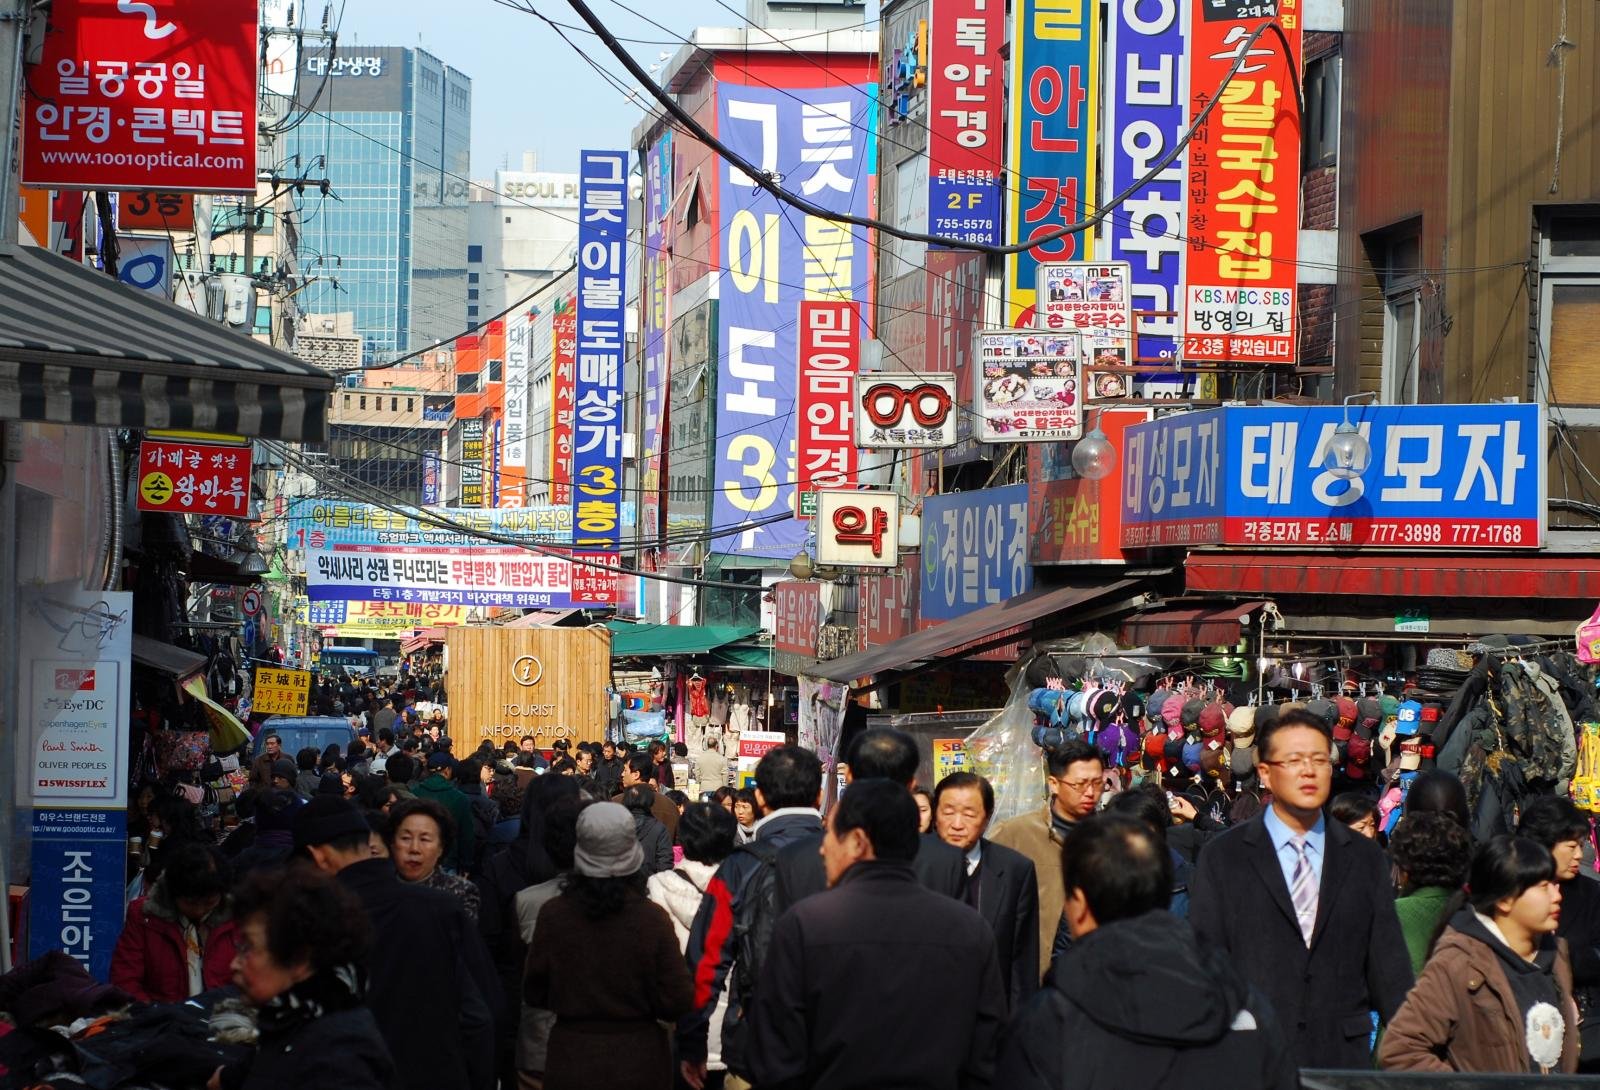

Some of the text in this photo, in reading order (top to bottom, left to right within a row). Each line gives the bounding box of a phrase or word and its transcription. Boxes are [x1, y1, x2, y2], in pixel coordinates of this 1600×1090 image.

[307, 56, 384, 77] 대한생명
[57, 58, 205, 99] 일공공일
[36, 105, 245, 145] 안경·콘텍트
[727, 98, 857, 197] 그릇
[42, 150, 244, 171] www.1001optical.com
[504, 182, 559, 199] SEOUL
[1216, 80, 1282, 280] 칼국수집
[936, 218, 993, 237] 755-5578
[1048, 268, 1072, 279] KBS
[1087, 267, 1121, 278] MBC
[1194, 289, 1290, 306] KBS.MBC.SBS
[1047, 313, 1126, 329] 손 칼국수
[1194, 310, 1284, 333] 방영의 집
[983, 336, 1005, 348] KBS
[1187, 338, 1296, 358] 2.3층 방있습니다
[804, 307, 855, 489] 믿음안경
[1012, 417, 1077, 430] 손 칼국수
[1126, 417, 1220, 514] 태성모자
[1239, 420, 1526, 507] 태성모자
[143, 473, 246, 510] 손 왕만두
[577, 466, 619, 532] 3층
[313, 504, 408, 531] 아름다움을
[297, 527, 326, 549] 1층
[833, 506, 888, 558] 약
[1252, 520, 1301, 543] 각종모자
[1369, 523, 1442, 544] 777-3898
[1451, 524, 1523, 544] 777-1768
[942, 502, 1028, 608] 경일안경
[318, 555, 363, 580] 악세사리
[367, 558, 390, 582] 상권
[393, 558, 448, 584] 무너뜨리는
[452, 559, 496, 586] 무분별한
[499, 561, 545, 588] 개발업자
[373, 588, 392, 600] E동
[417, 590, 463, 603] 개발저지
[467, 592, 514, 605] 비상대책
[517, 593, 551, 606] 위원회
[777, 587, 818, 648] 믿음안경
[260, 672, 306, 687] 京城社
[503, 704, 556, 717] TOURIST
[481, 725, 578, 739] INFORMATION
[42, 739, 104, 753] Paul Smith
[38, 761, 107, 770] OLIVER PEOPLES
[50, 779, 107, 789] SWISSFLEX
[61, 851, 94, 973] 조은안
